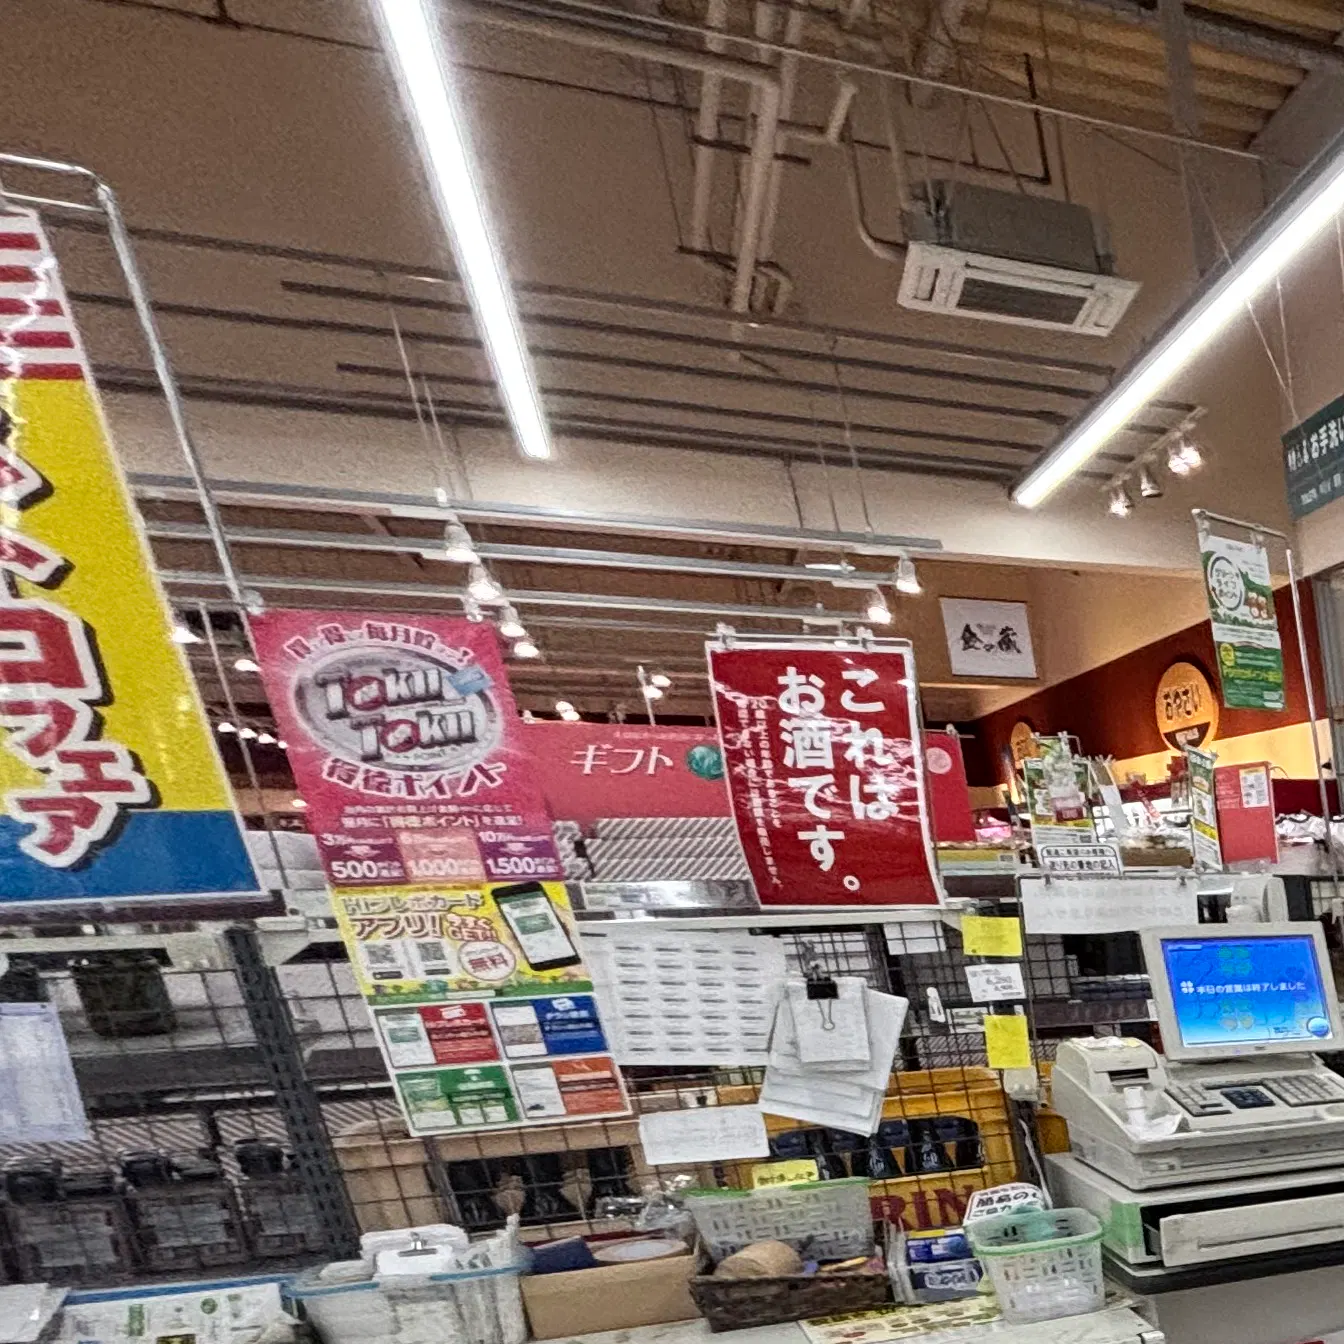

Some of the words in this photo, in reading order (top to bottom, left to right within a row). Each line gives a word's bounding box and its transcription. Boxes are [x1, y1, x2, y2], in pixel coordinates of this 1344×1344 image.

[838, 664, 900, 822] これは
[569, 742, 675, 777] ギフト
[776, 664, 861, 892] お酒です。
[331, 858, 379, 879] 500
[468, 953, 510, 973] 無料
[1196, 981, 1307, 995] 本日の営業は終了しました
